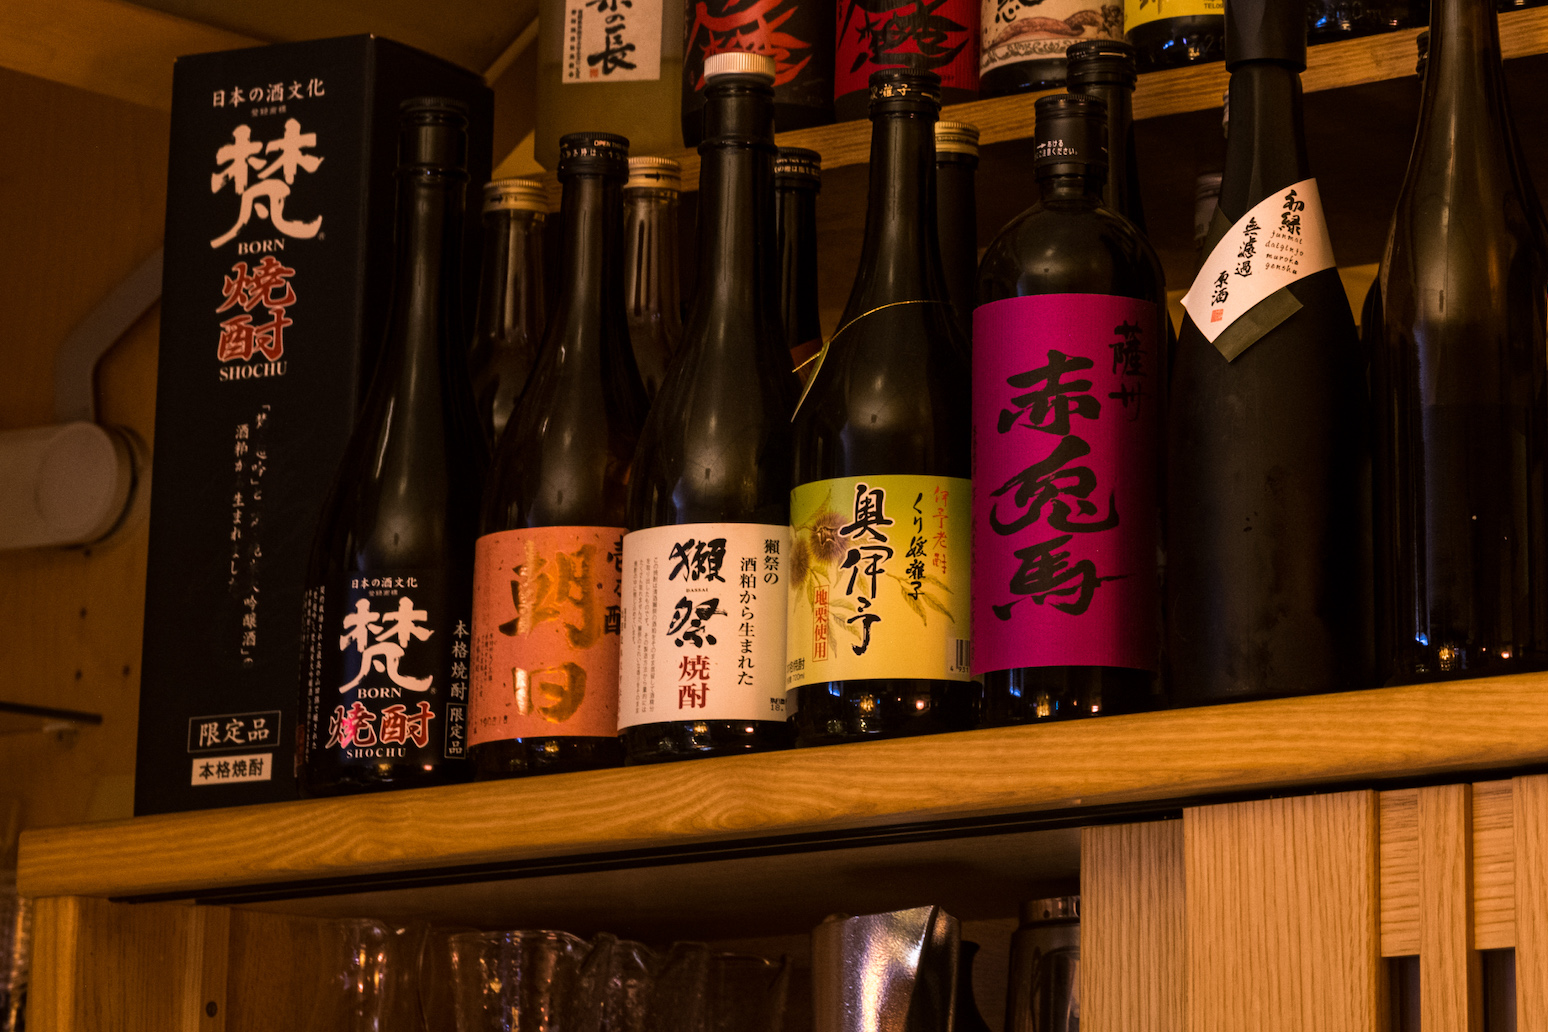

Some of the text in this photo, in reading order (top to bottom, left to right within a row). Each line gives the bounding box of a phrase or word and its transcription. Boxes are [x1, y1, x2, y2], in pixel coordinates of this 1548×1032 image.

[212, 77, 325, 108] 日本の酒文化
[210, 118, 325, 250] 梵
[238, 238, 286, 256] BORN
[215, 255, 297, 363] 焼酎
[1211, 270, 1230, 307] 原酒
[219, 361, 288, 383] SHOCHU
[351, 576, 419, 589] 日本の酒文化
[763, 538, 781, 585] 獺祭の
[838, 484, 894, 656] 奥伊予
[666, 538, 728, 648] 獺祭
[338, 596, 435, 695] 梵
[737, 557, 757, 687] 酒粕から生まれた
[814, 587, 828, 659] 地栗使用
[450, 619, 470, 702] 本格焼酎
[678, 654, 711, 710] 焼酎
[357, 687, 403, 699] BORN
[199, 718, 271, 748] 限定品
[325, 701, 436, 749] 焼酎
[449, 707, 464, 755] 限定品
[198, 757, 265, 780] 本格焼酎
[346, 748, 407, 759] SHOCHU
